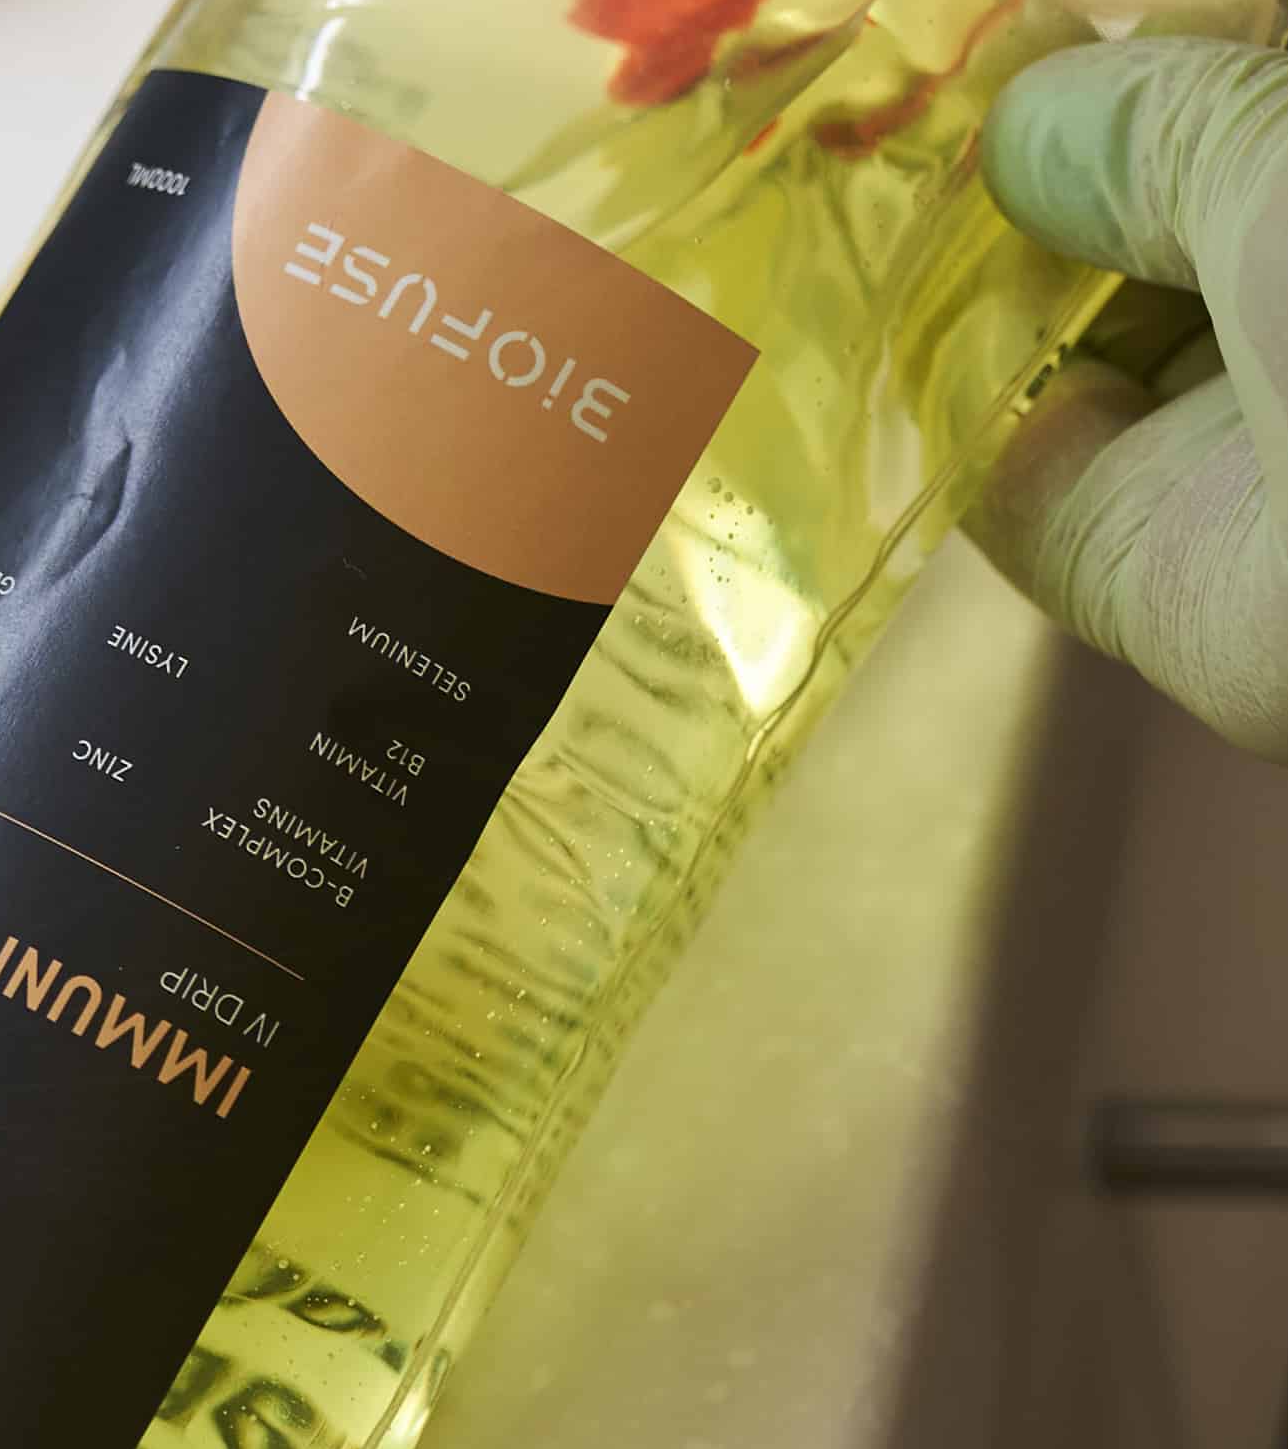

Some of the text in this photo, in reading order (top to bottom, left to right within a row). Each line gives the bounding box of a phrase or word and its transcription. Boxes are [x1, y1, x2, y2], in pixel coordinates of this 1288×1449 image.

[127, 162, 190, 196] 1000ML
[107, 625, 189, 679] LYSINE
[348, 616, 471, 701] SELENIUM
[72, 739, 133, 782] ZINC
[308, 732, 408, 806] VITAMIN
[386, 739, 426, 776] B12
[201, 807, 355, 908] B-COMPLEX
[252, 797, 368, 879] VITAMINS
[159, 967, 280, 1048] IV DRIP
